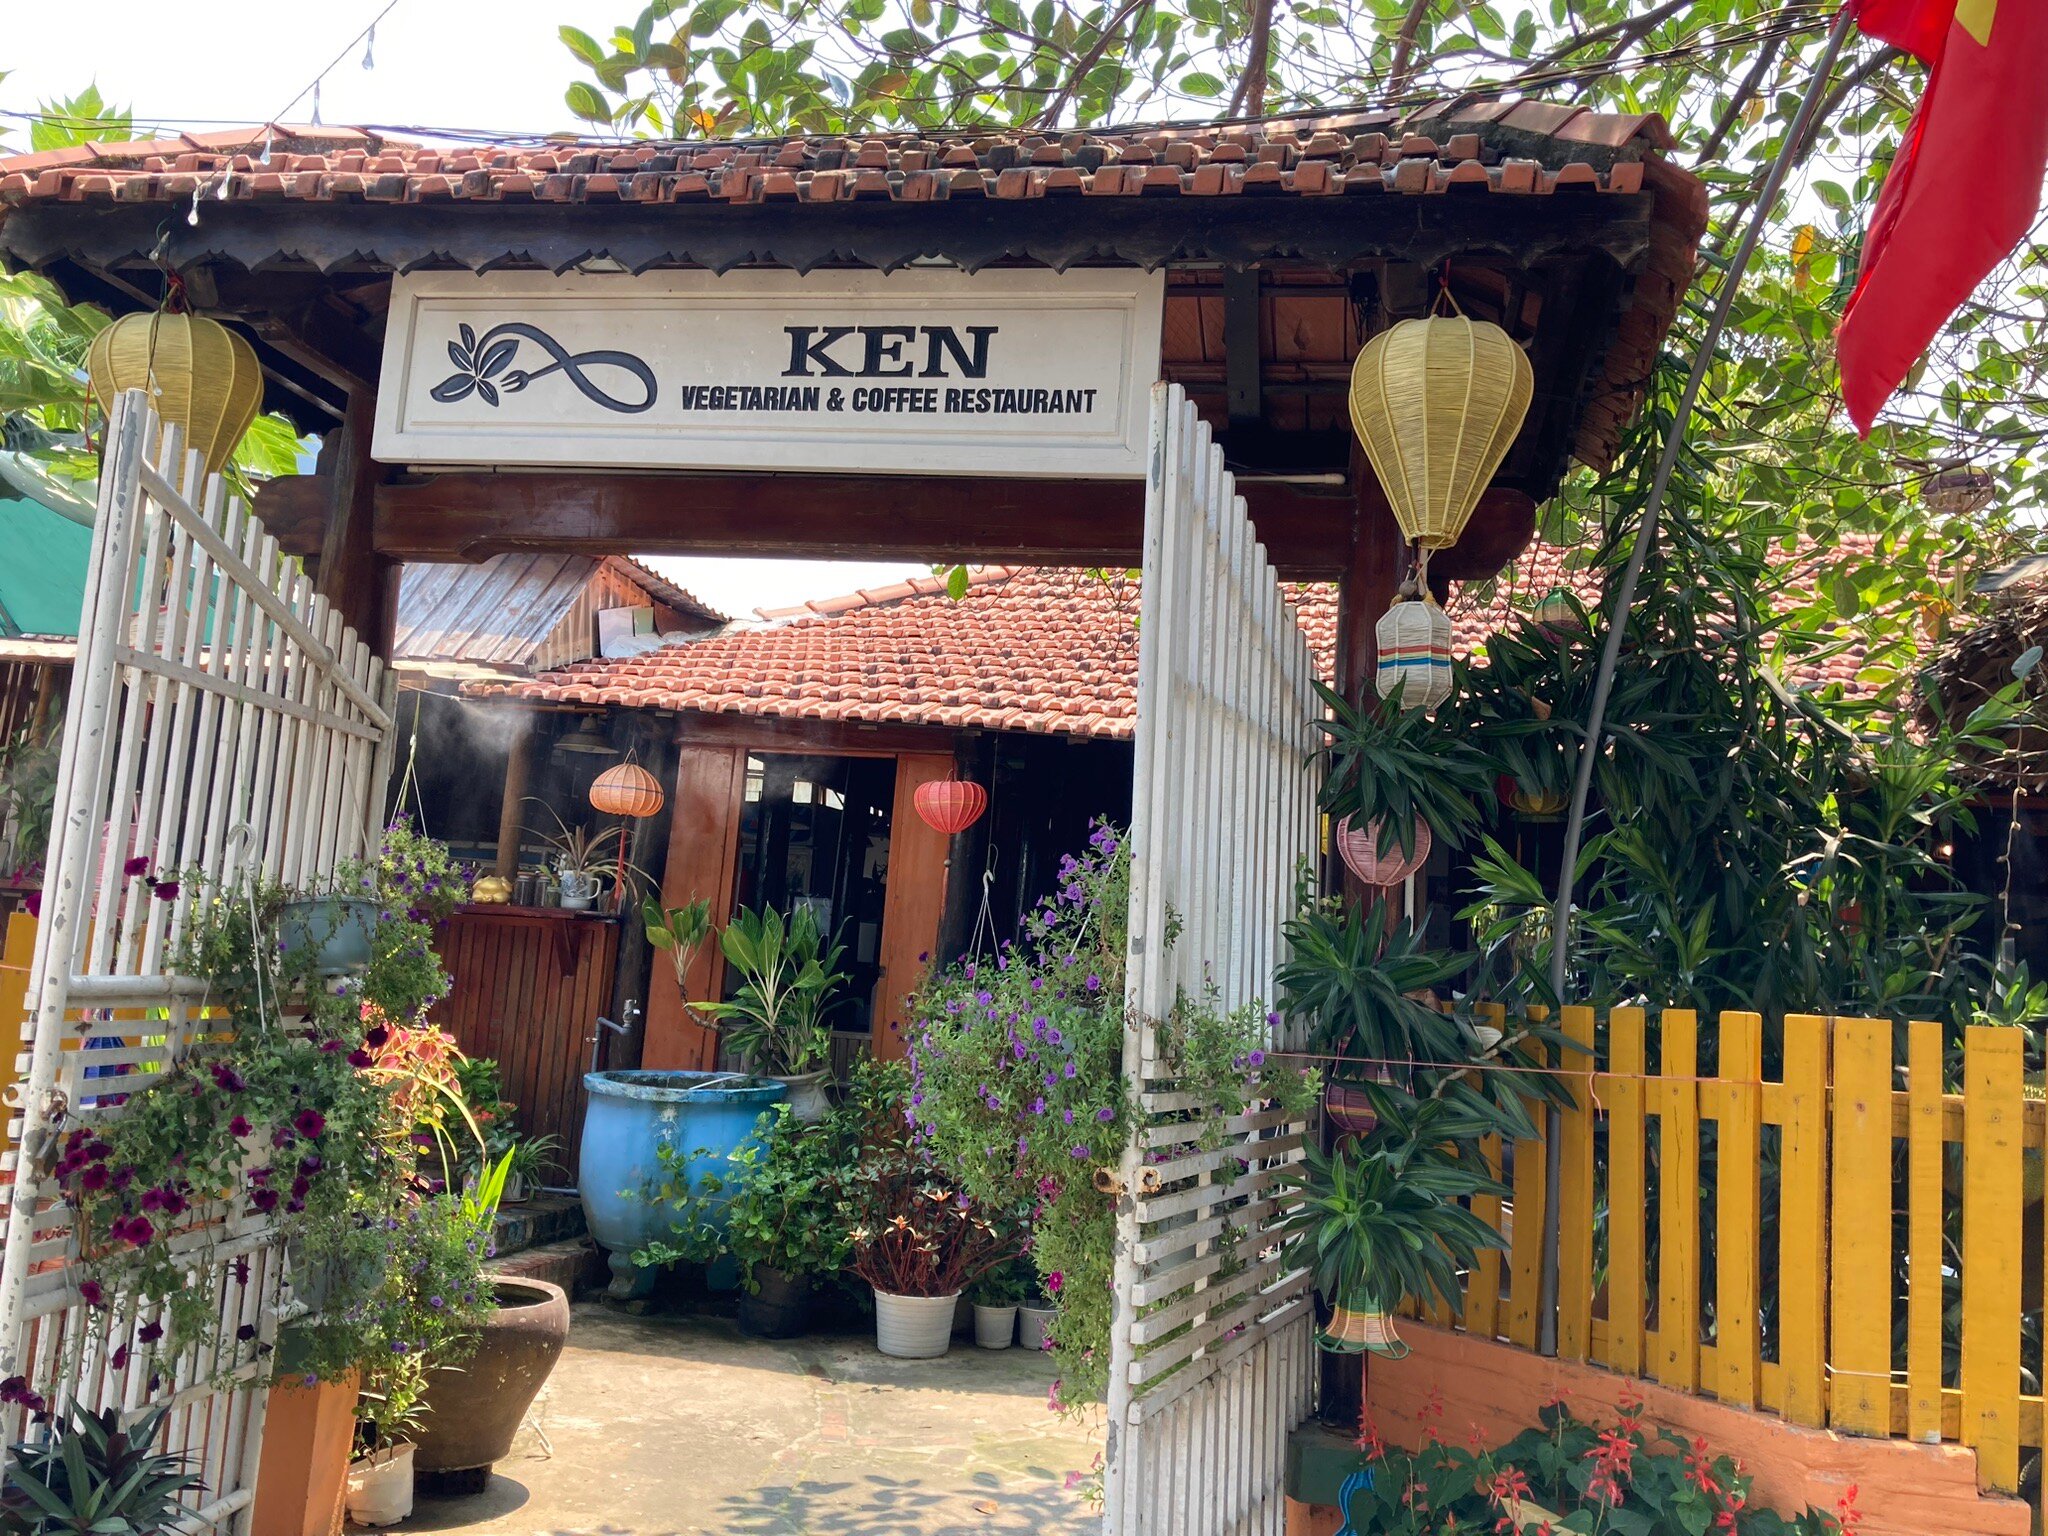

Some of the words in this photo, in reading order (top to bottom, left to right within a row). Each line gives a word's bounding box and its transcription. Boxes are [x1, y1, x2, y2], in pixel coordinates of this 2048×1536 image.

[780, 325, 999, 379] KEN
[682, 386, 821, 412] VEGETARIAN
[826, 387, 846, 412] &
[852, 387, 939, 413] COFFEE
[944, 388, 1098, 414] RESTAURANT
